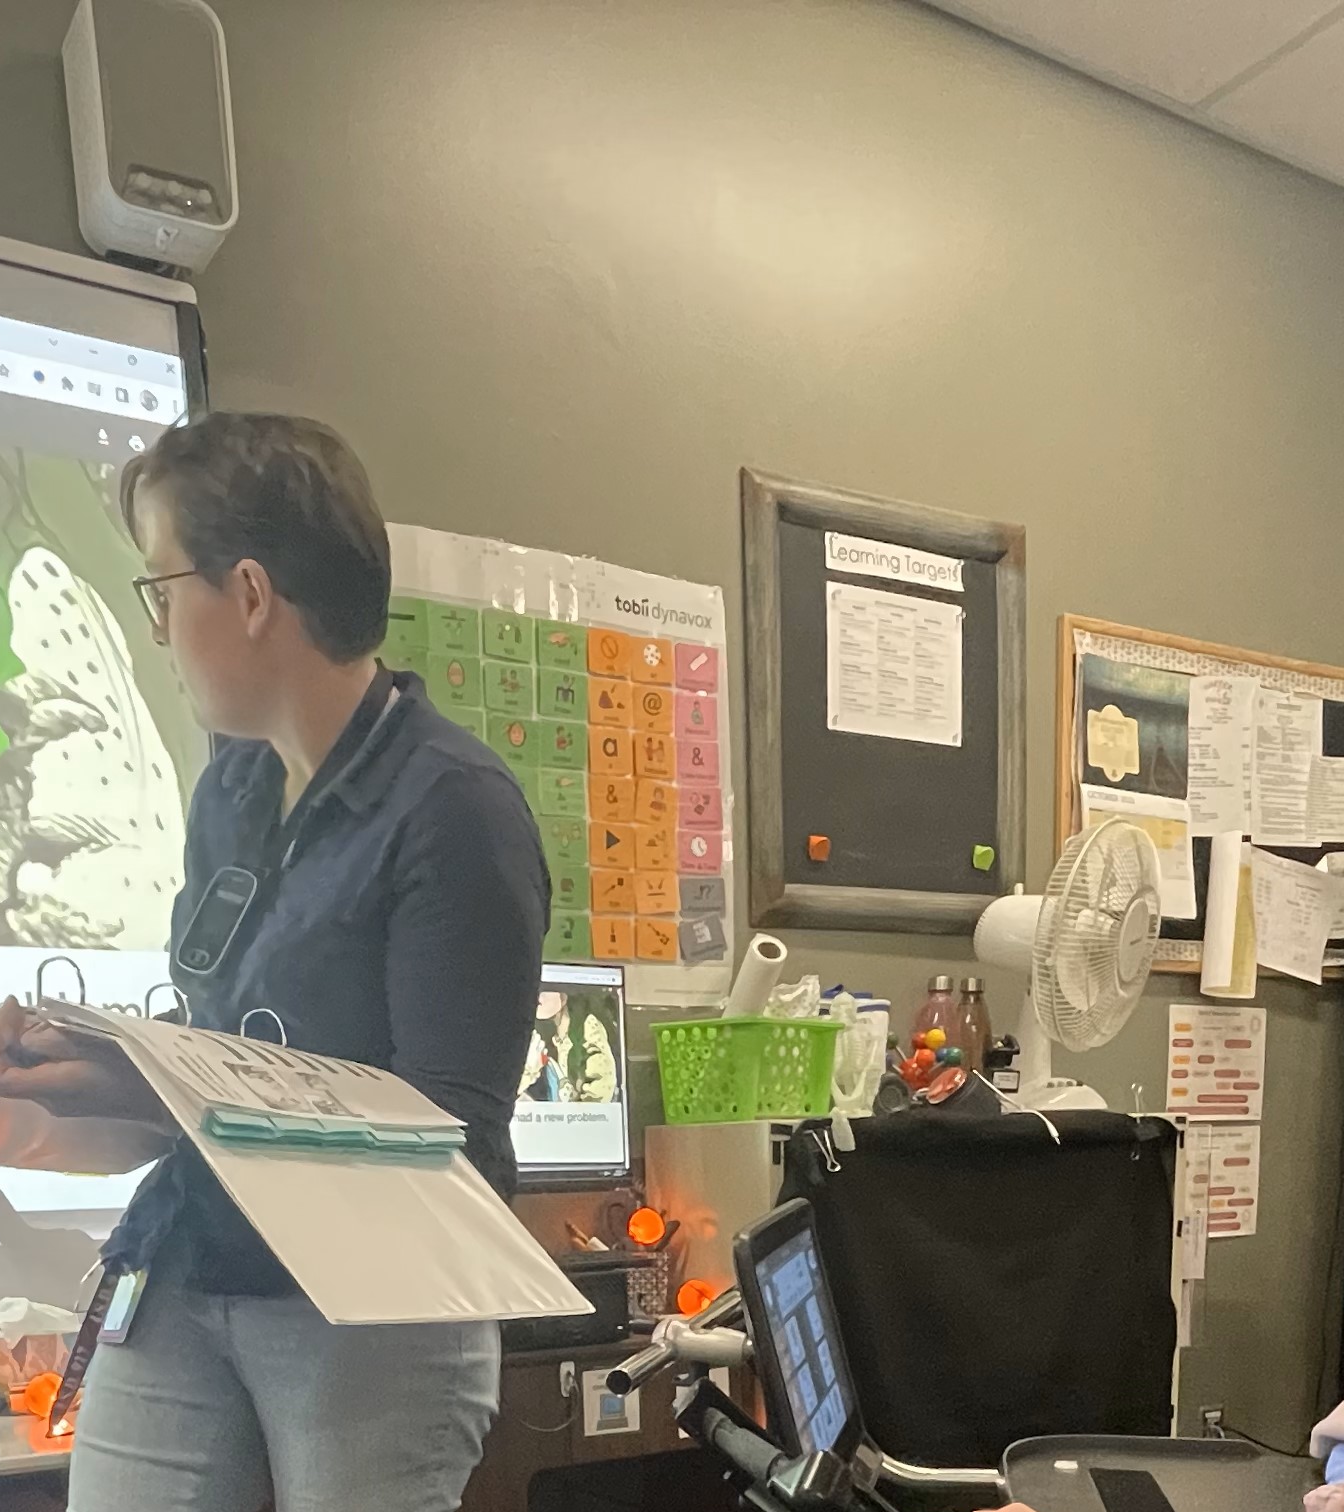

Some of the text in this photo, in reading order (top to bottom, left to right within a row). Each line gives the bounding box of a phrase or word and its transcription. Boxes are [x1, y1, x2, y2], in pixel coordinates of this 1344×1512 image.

[829, 536, 960, 583] Learning Targets
[614, 594, 714, 630] tobii dynavox
[535, 1113, 542, 1123] a
[543, 1113, 565, 1123] new
